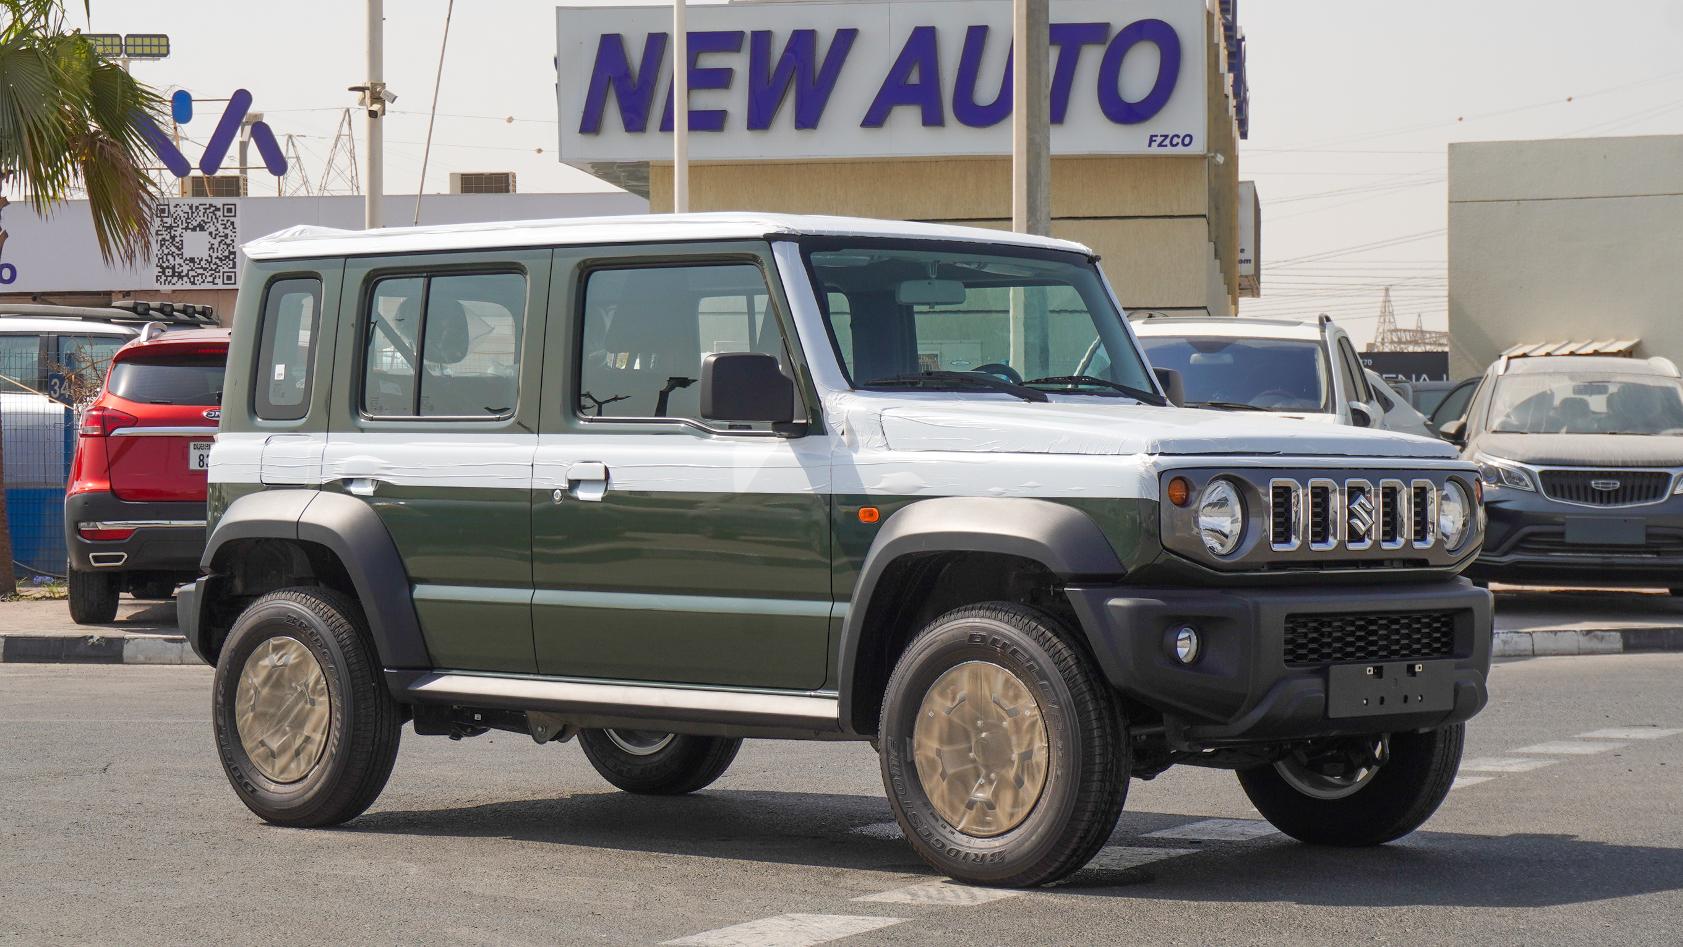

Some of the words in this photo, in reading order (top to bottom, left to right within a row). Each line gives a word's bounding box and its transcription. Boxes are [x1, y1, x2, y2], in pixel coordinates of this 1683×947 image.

[579, 28, 859, 134] NEW
[860, 18, 1182, 128] AUTO
[1148, 134, 1193, 147] FZCO
[50, 379, 69, 399] 34
